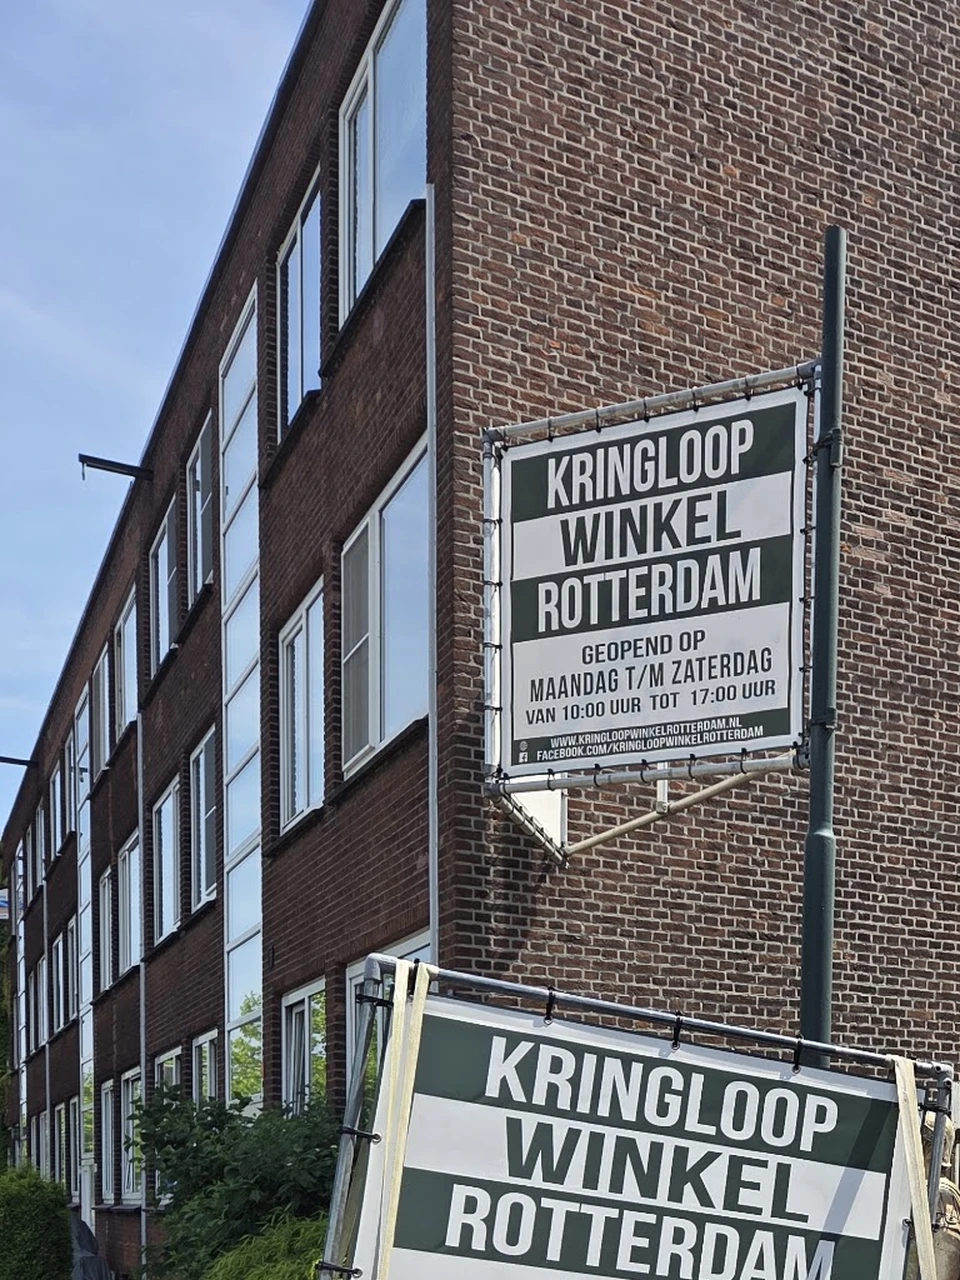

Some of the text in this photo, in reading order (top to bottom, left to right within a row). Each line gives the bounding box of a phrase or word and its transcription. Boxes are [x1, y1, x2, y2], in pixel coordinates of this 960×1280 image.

[547, 419, 754, 509] KRINGLOOP
[561, 490, 741, 567] WINKEL
[538, 548, 760, 632] ROTTERDAM
[530, 647, 772, 702] MAANDAG T/M ZATERDAG
[582, 629, 705, 665] GEOPEND OP
[526, 679, 775, 724] VAN 10:00 UUR TOT 17:00 UUR
[550, 715, 742, 747] WWW.KRINGLOOPWINKELROTTERDAM.NL
[537, 726, 764, 761] FACEBOOK.COM/KRINGLOOPWINKELROTTERDAM
[484, 1036, 839, 1153] KRINGLOOP
[504, 1116, 810, 1223] WINKEL
